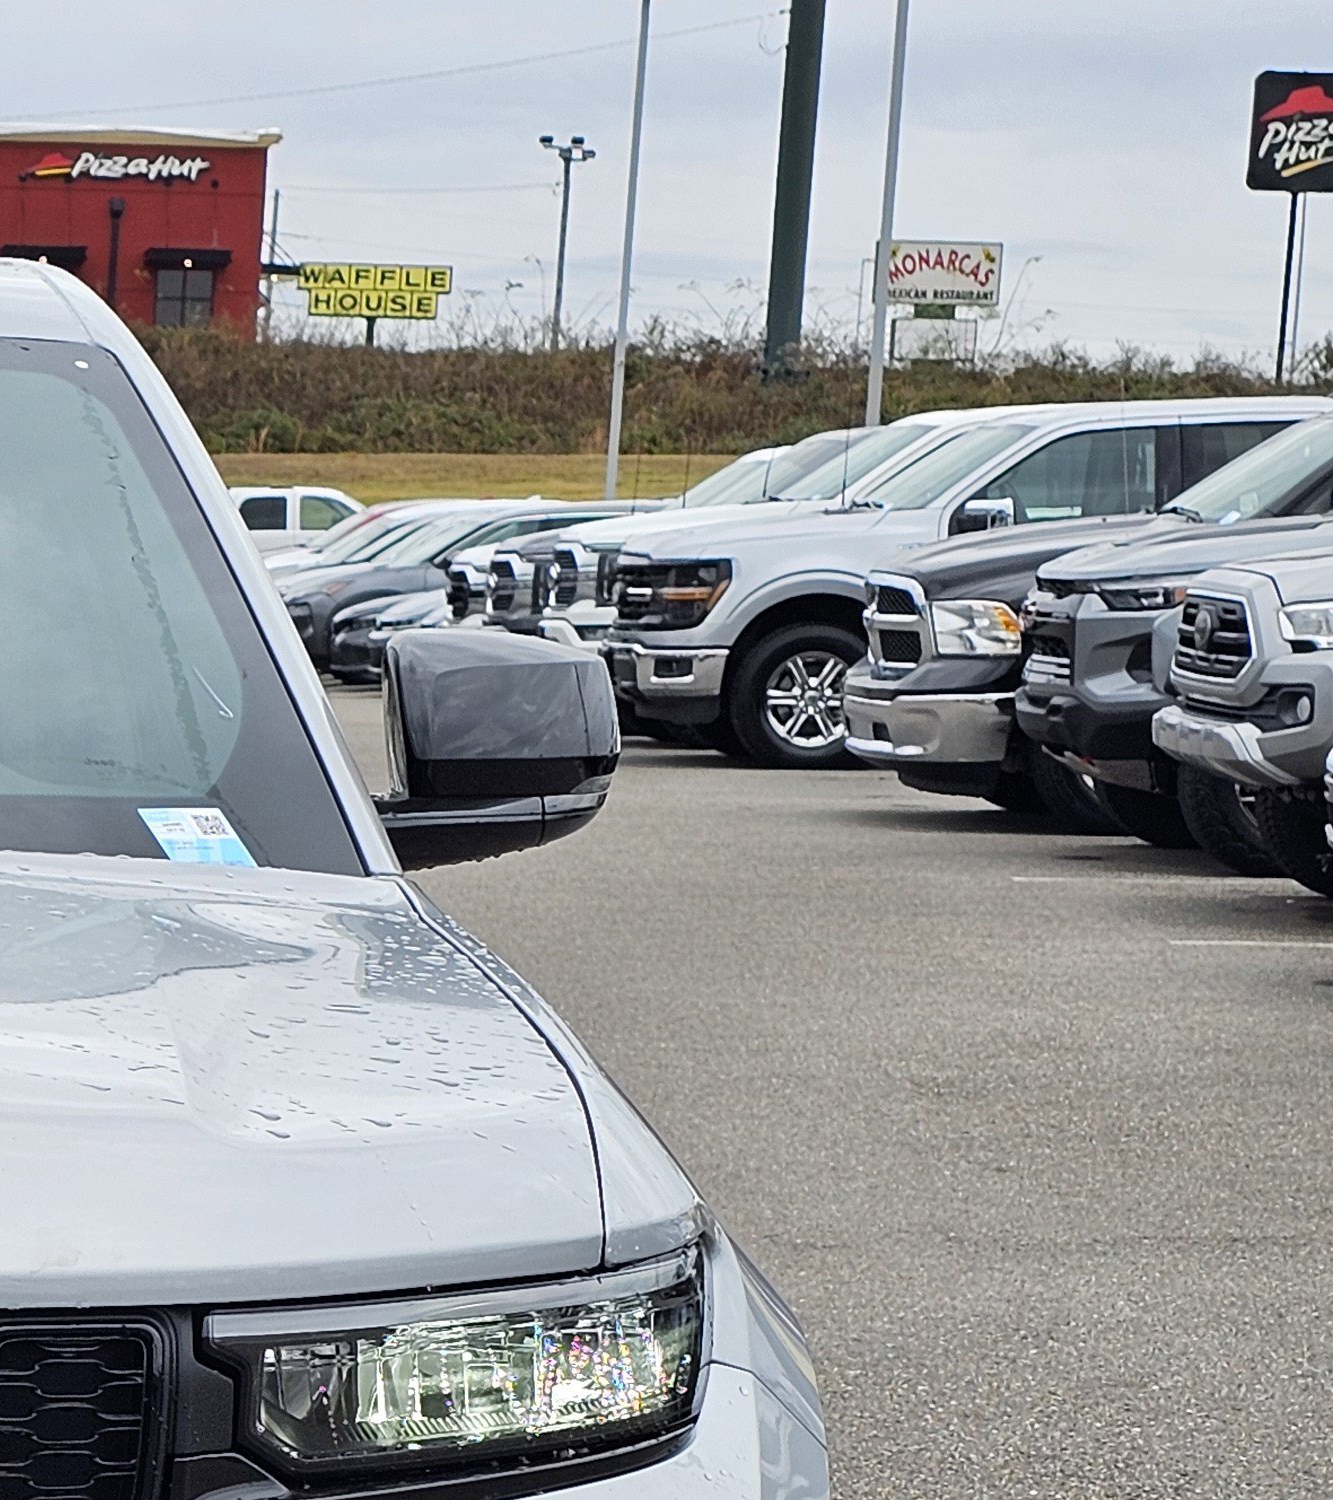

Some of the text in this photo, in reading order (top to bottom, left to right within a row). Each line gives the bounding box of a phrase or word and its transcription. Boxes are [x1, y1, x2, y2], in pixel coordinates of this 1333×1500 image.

[1258, 114, 1333, 159] Pizz
[71, 152, 210, 181] Pizza Hut
[303, 267, 447, 288] WAFFLE
[888, 248, 995, 287] MONARCAS
[314, 293, 433, 313] HOUSE
